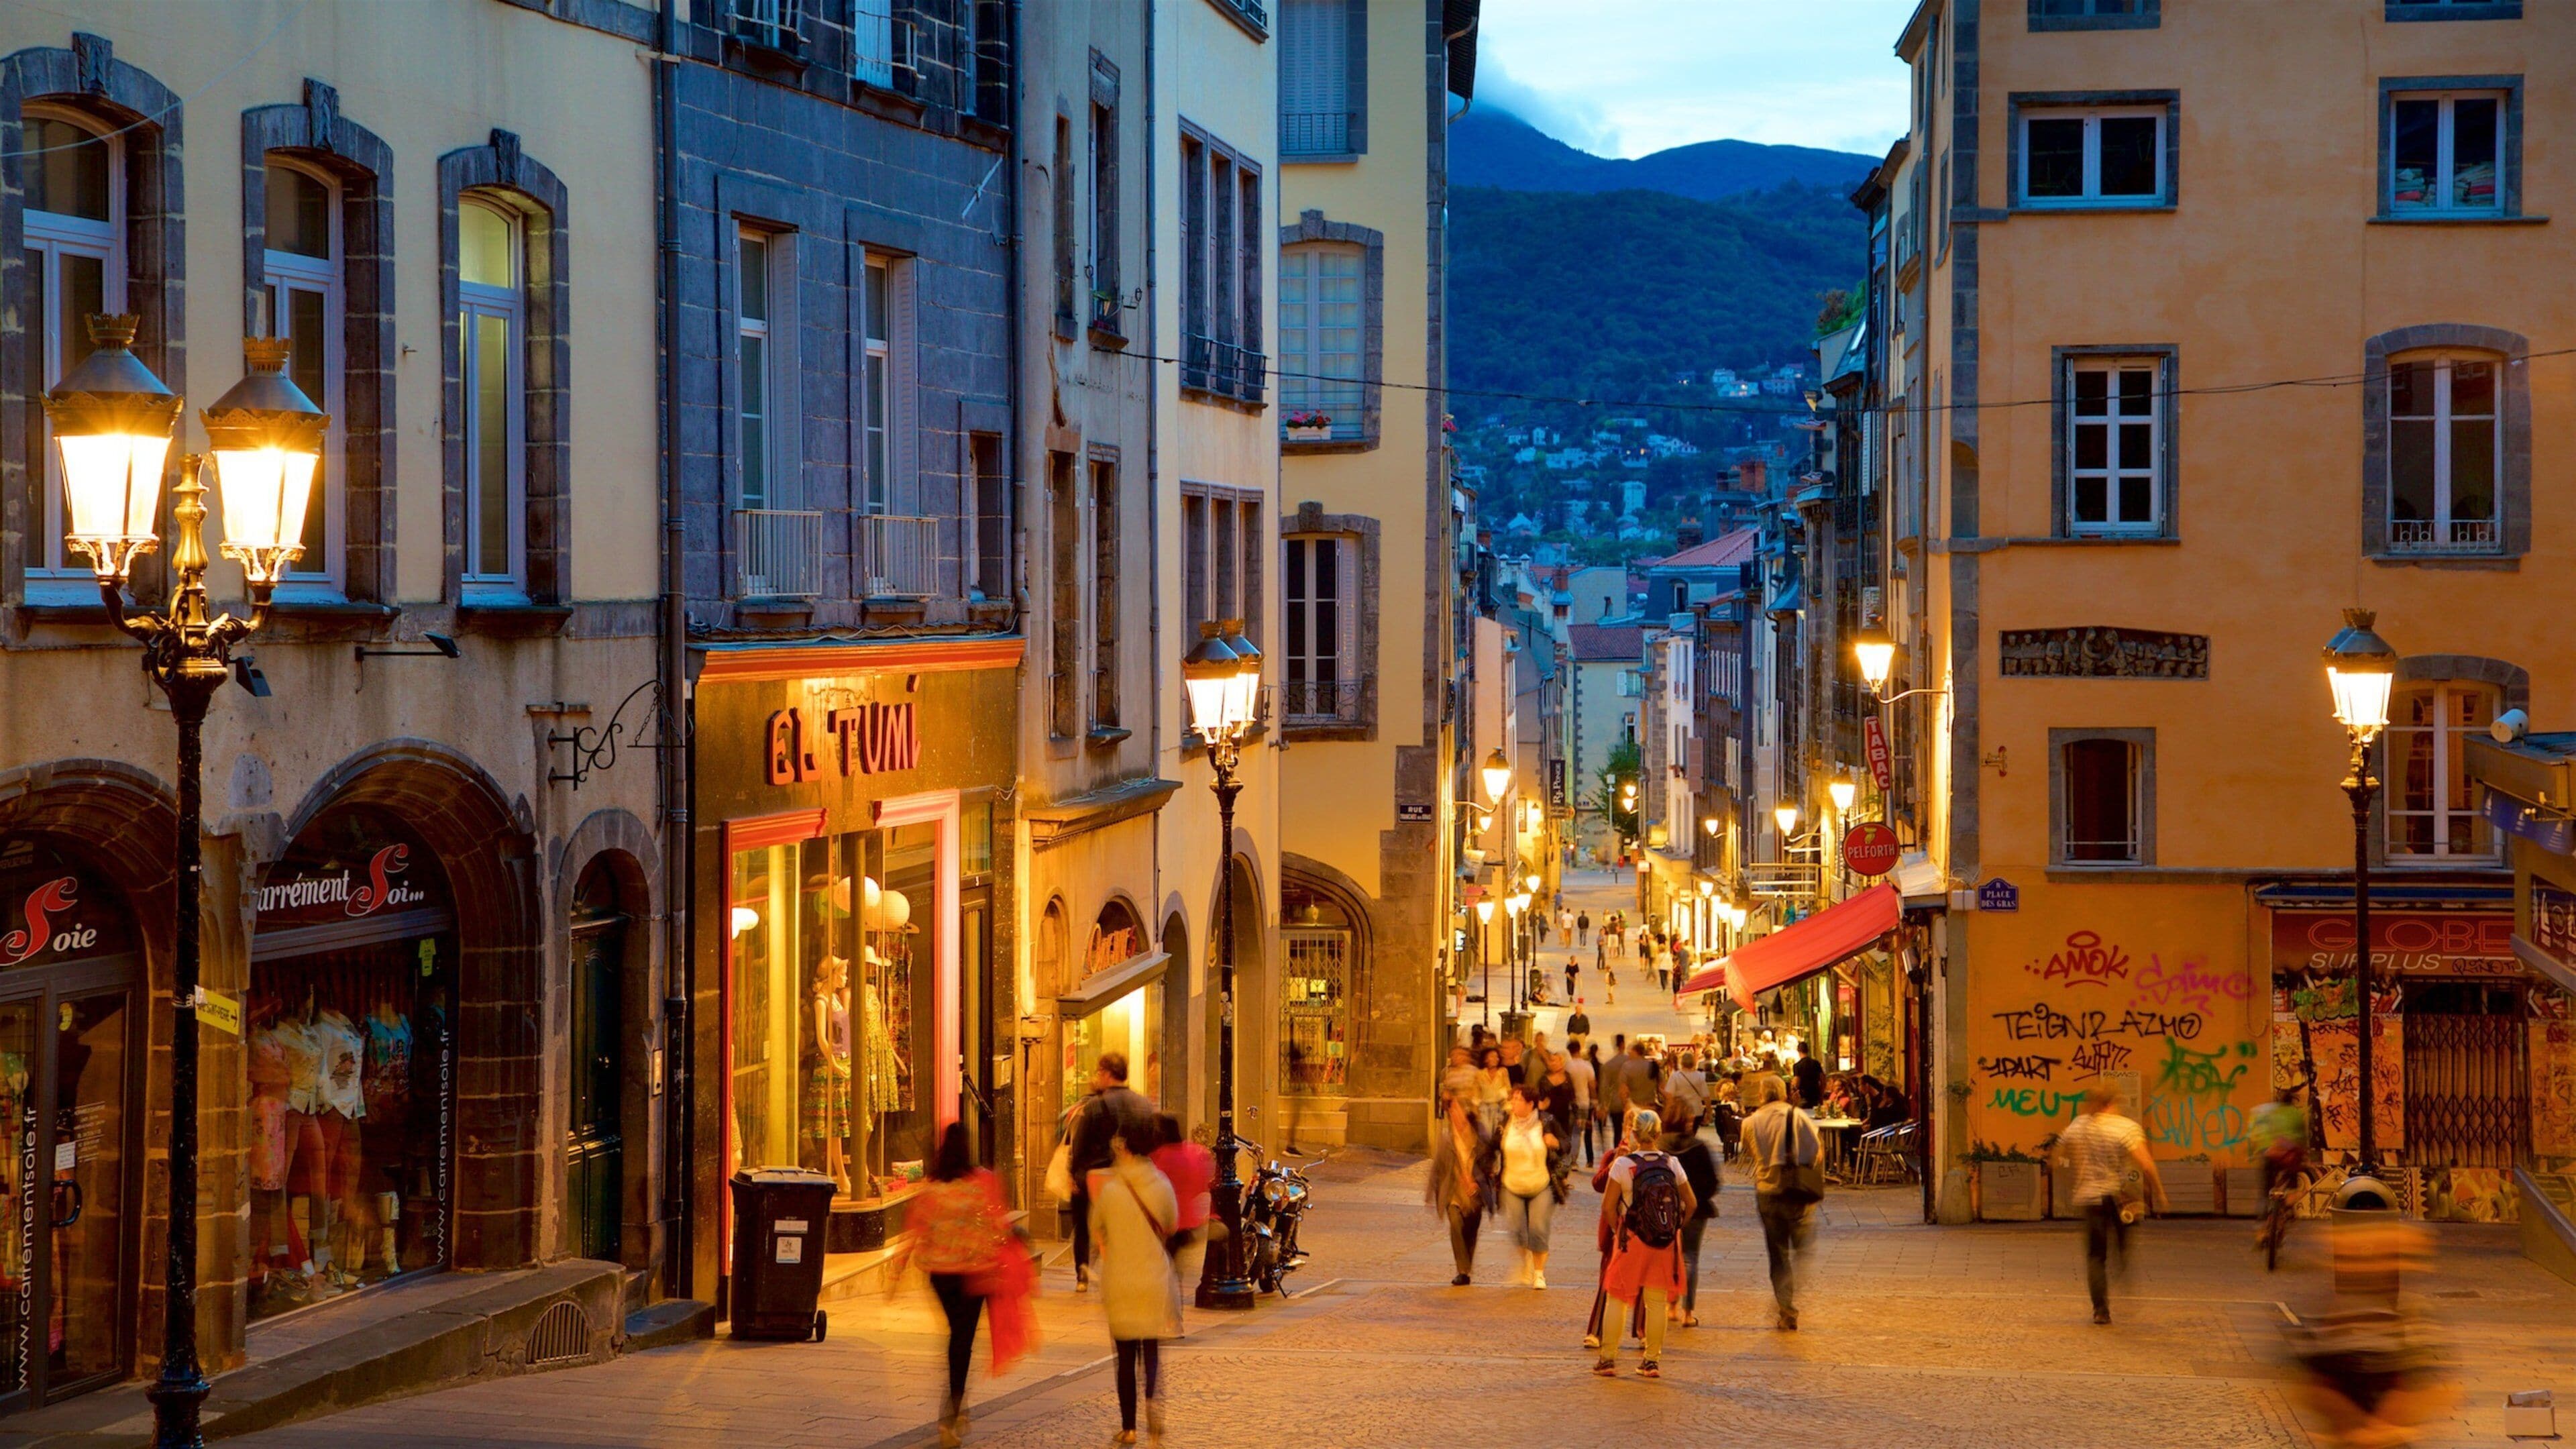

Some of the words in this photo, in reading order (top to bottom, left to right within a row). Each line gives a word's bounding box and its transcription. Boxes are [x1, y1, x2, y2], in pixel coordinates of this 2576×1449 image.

[765, 707, 822, 786] EL
[1868, 720, 1889, 788] TABAC
[1847, 843, 1896, 859] PELFORTH
[257, 869, 351, 912] arrément
[1981, 900, 1995, 908] DES
[1996, 899, 2015, 908] GRAS
[1986, 890, 2011, 898] PLACE
[2308, 918, 2515, 953] GOBE
[1669, 1046, 1695, 1054] PIZZA
[17, 1106, 38, 1391] www.carrementsoie.fr
